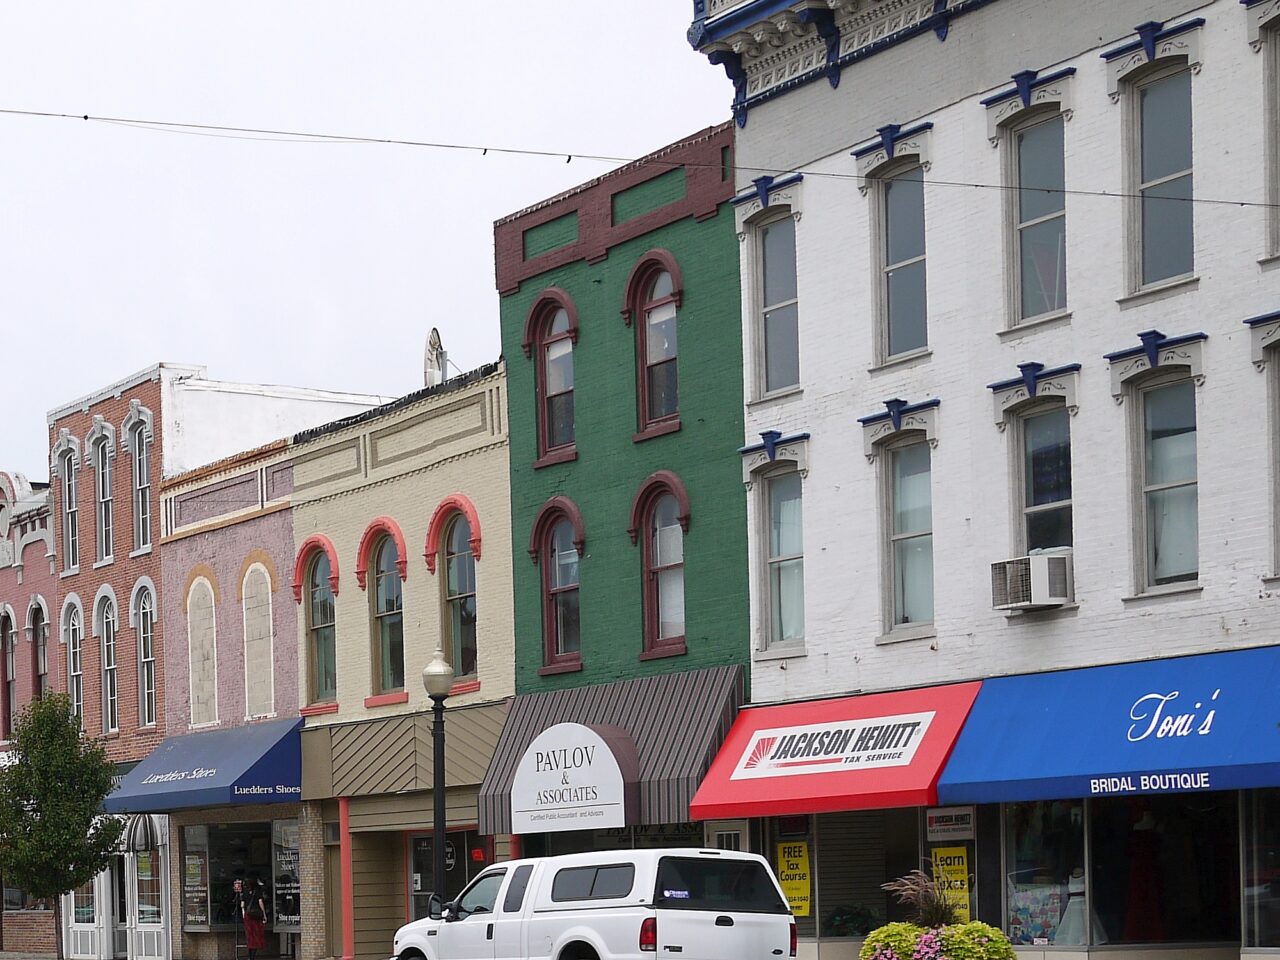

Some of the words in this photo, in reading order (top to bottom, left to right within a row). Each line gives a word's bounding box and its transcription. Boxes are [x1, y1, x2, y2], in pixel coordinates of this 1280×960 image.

[1127, 688, 1220, 742] Toni's
[770, 728, 856, 761] JACKSON
[851, 721, 921, 752] HEWITT
[536, 745, 596, 772] PAVLOV
[844, 756, 861, 764] TAX
[865, 751, 903, 762] SERVICE
[141, 771, 189, 784] Luedders
[187, 767, 217, 780] Shoes
[561, 771, 570, 786] &
[1090, 776, 1136, 793] BRIDAL
[1140, 772, 1210, 790] BOUTIQUE
[234, 785, 273, 794] Luedders
[275, 785, 301, 794] Shoes
[536, 786, 598, 805] ASSOCIATES
[530, 813, 545, 821] Certified
[545, 812, 557, 820] Public
[782, 845, 803, 859] FREE
[934, 852, 965, 867] Learn
[786, 860, 800, 871] Tax
[780, 871, 807, 881] Course
